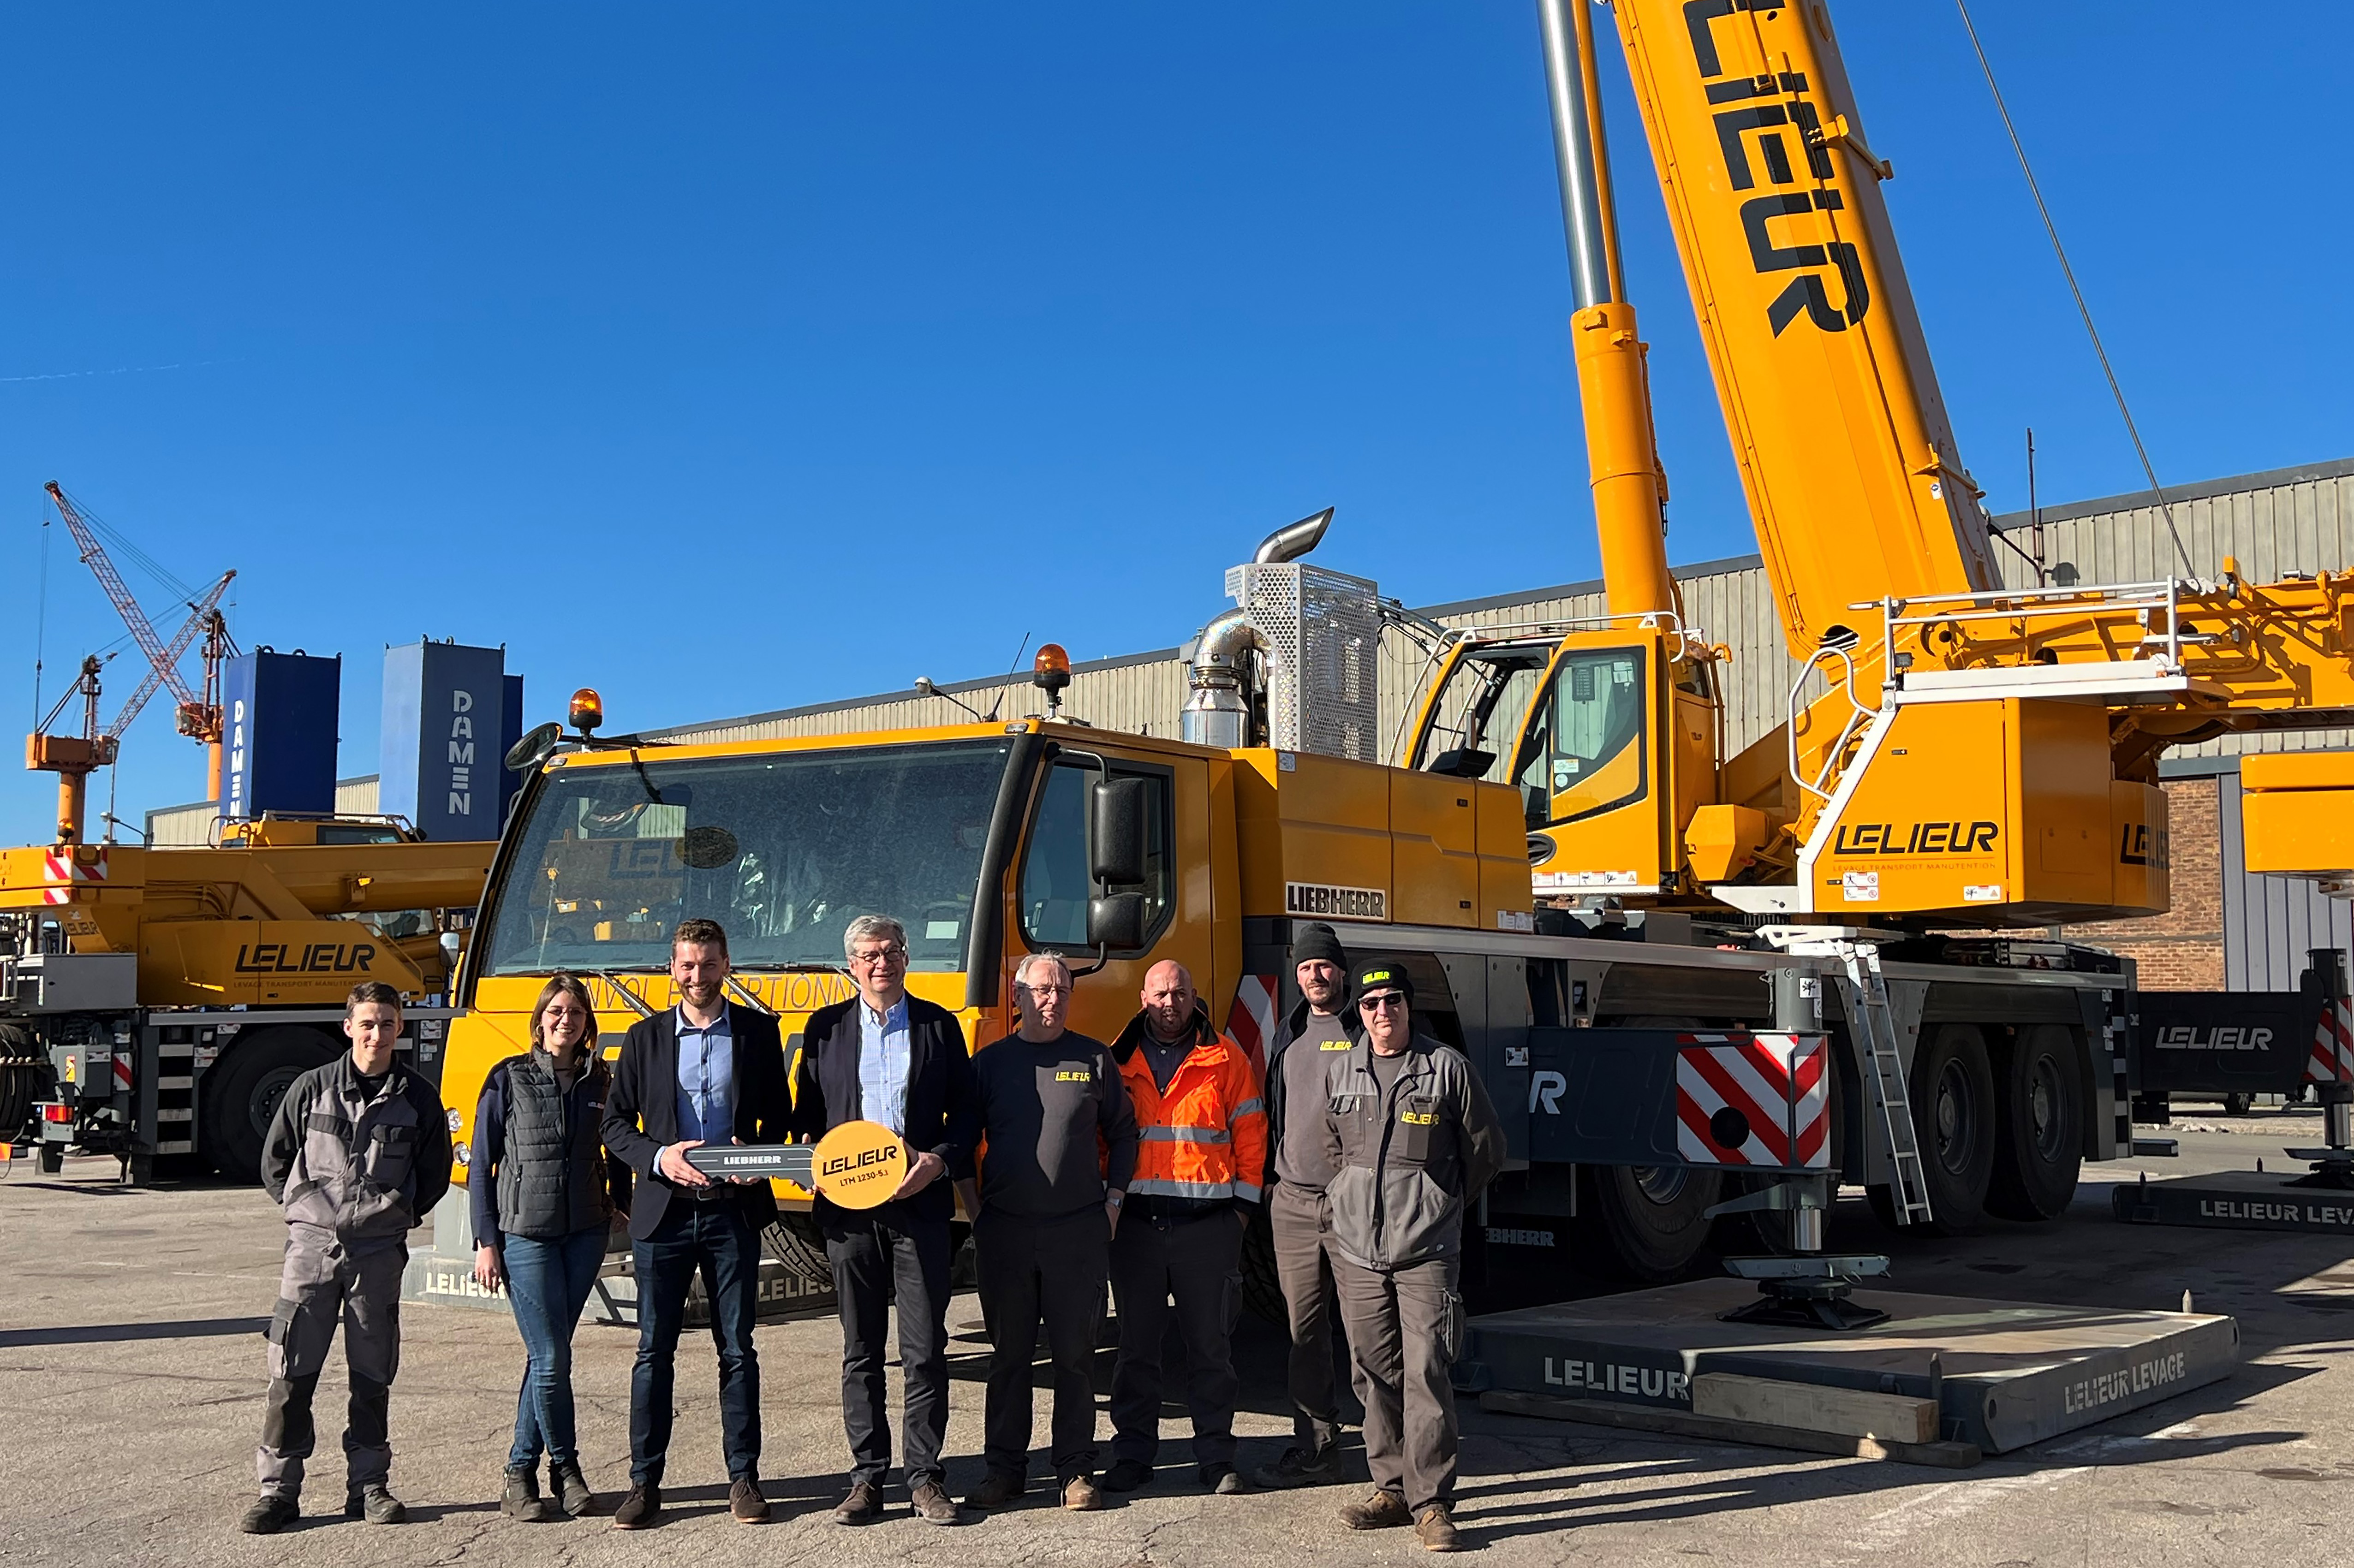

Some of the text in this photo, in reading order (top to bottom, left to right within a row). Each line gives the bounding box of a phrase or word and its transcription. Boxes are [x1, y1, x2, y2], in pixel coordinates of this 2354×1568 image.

[230, 700, 244, 824] DAMEN
[448, 690, 474, 815] DAMEN
[1834, 821, 1998, 854] LELIEUR
[1287, 885, 1384, 917] LIEBHERR
[235, 944, 375, 972] LELIEUR
[2155, 1027, 2273, 1050] LELIEUR
[723, 1156, 782, 1165] LIEBHERR
[822, 1145, 897, 1176] LELIEUR
[840, 1176, 856, 1187] LTM
[2200, 1200, 2354, 1225] LELIEUR LEV
[1545, 1357, 1691, 1401] LELIEUR
[2064, 1352, 2186, 1414] LELIEUR LEVAGE
